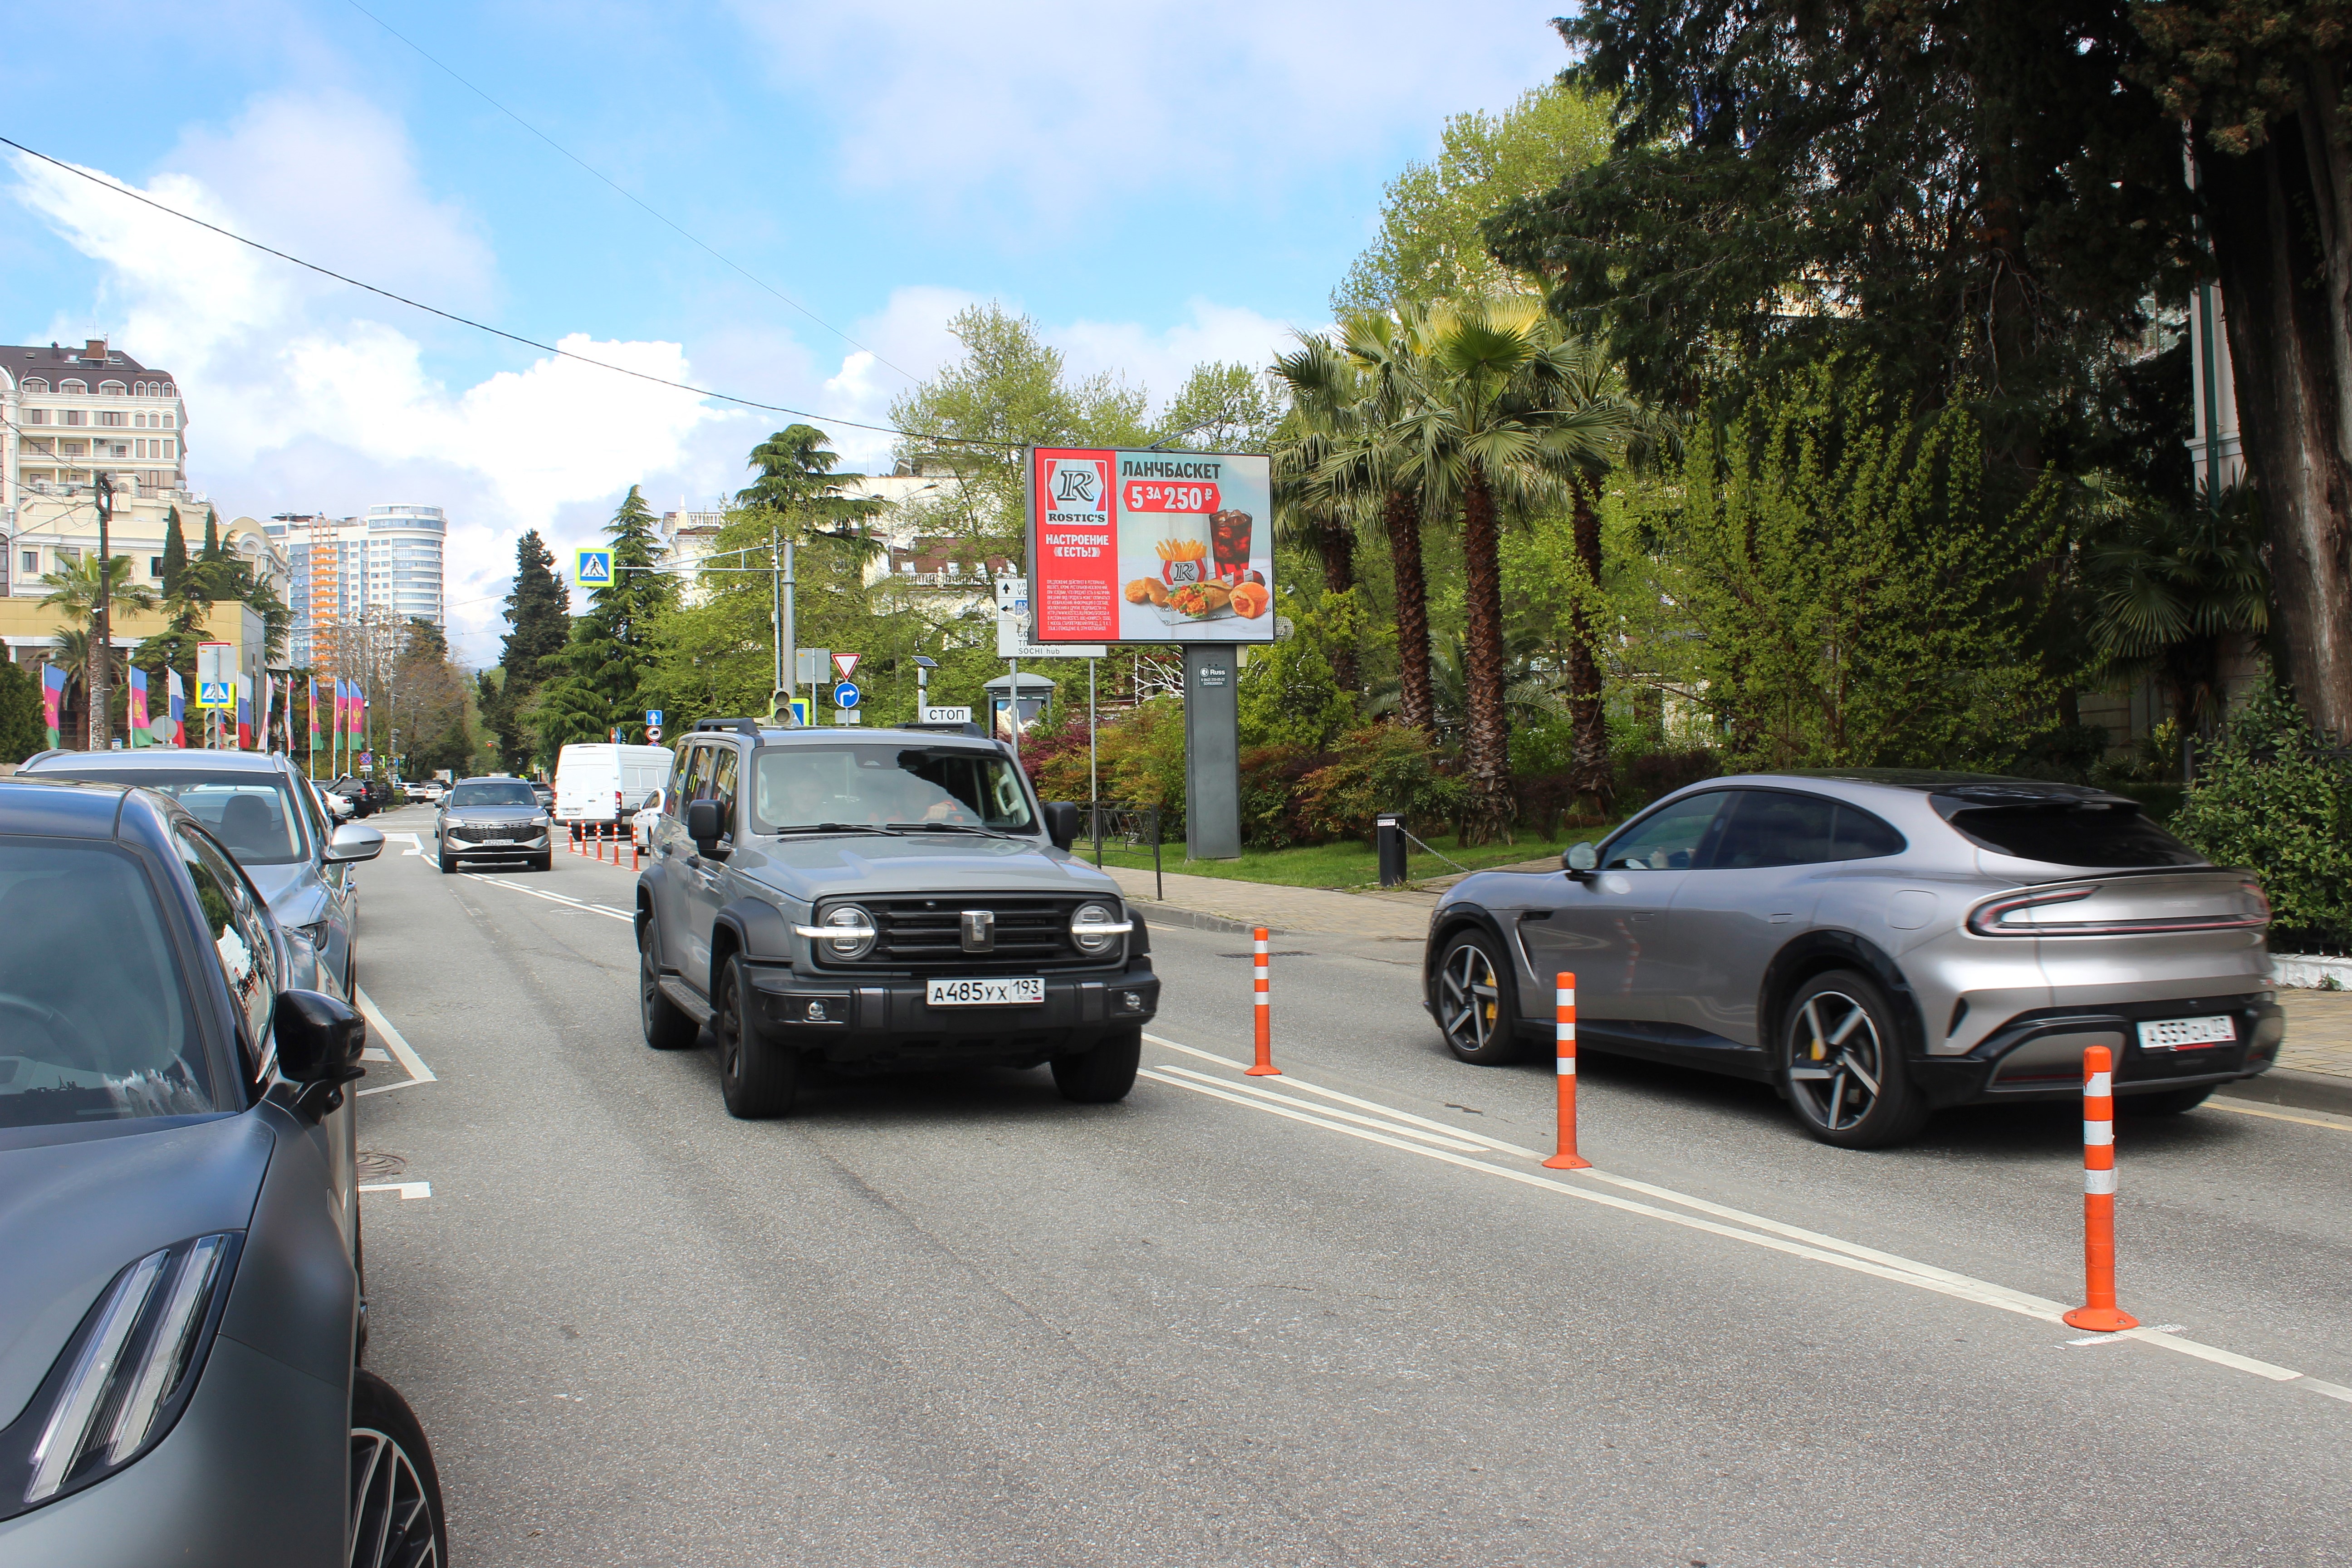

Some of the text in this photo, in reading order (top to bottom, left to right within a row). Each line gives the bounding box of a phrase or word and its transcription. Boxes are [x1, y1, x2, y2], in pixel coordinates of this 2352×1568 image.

[1122, 461, 1221, 479] ЛАНЧБАСКЕТ
[1131, 486, 1143, 509] 5
[1146, 486, 1161, 500] ЗА
[1164, 487, 1202, 510] 250
[1048, 513, 1105, 522] ROSTIC'S
[1045, 534, 1109, 545] НАСТРОЕНИЕ
[1064, 547, 1092, 557] ЕСТЬ!
[930, 710, 964, 720] СТОП
[934, 980, 1039, 1002] А485УХ 193
